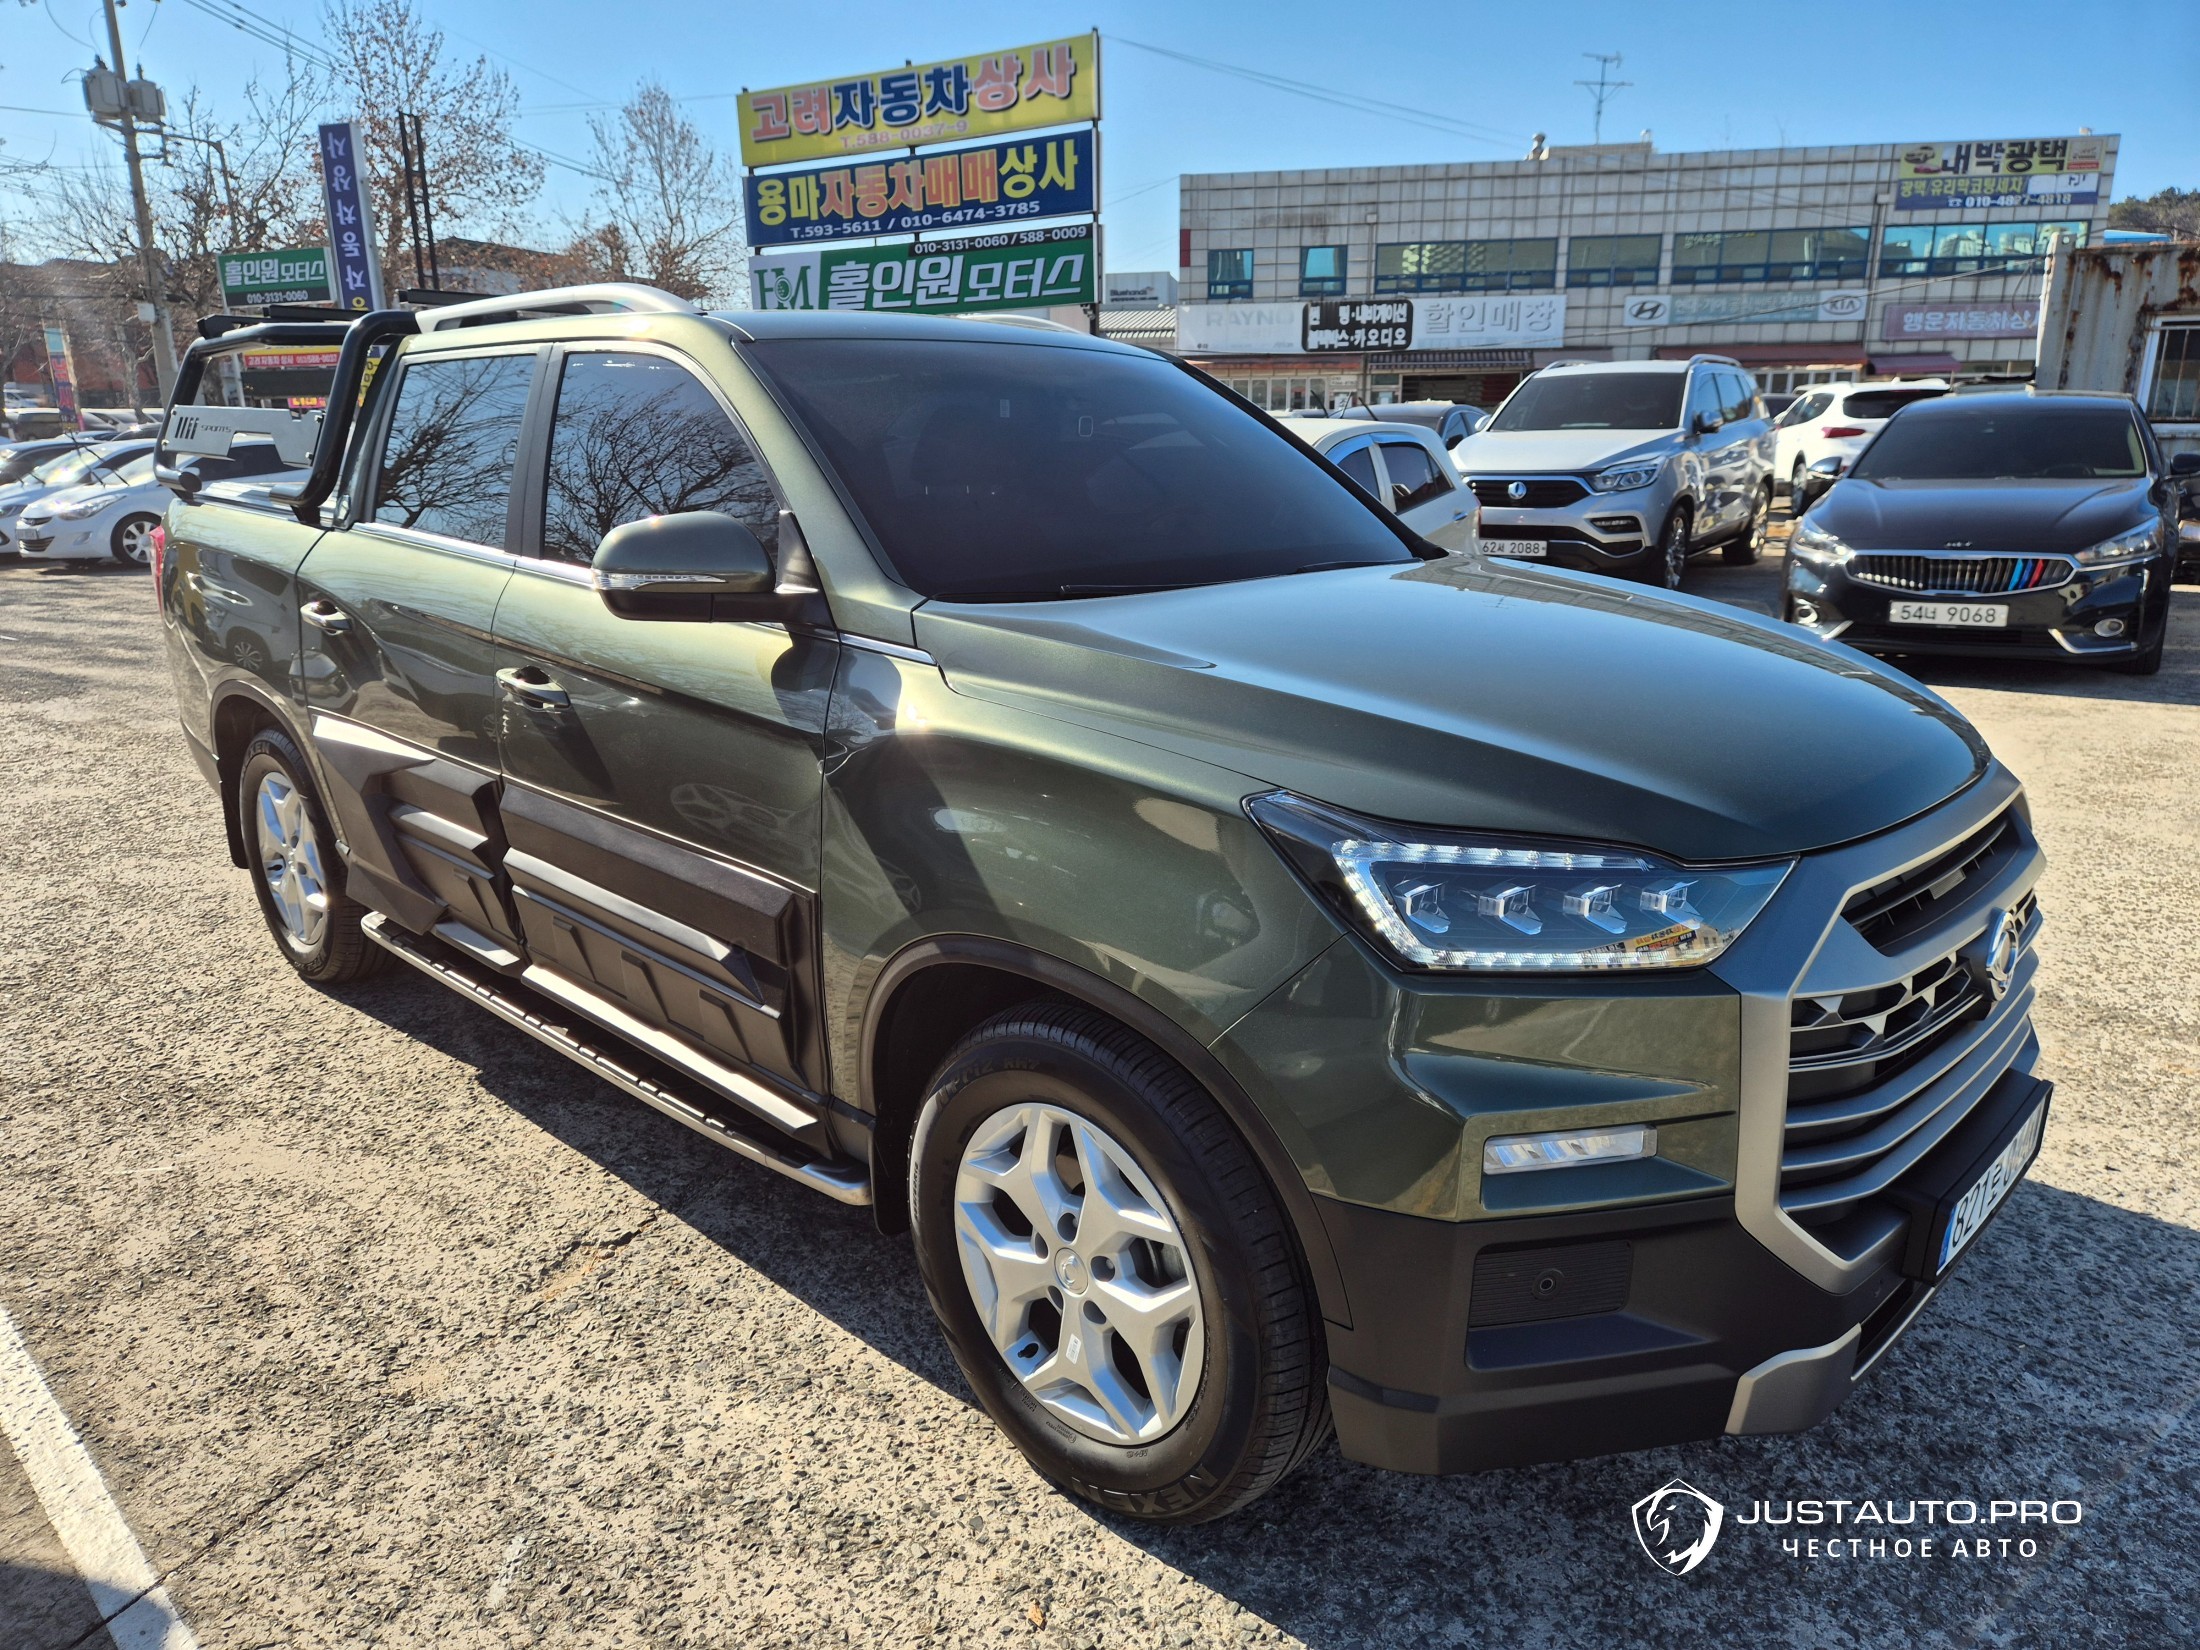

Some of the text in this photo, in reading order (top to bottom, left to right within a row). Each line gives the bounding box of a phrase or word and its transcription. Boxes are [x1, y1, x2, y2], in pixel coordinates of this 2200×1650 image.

[751, 43, 1076, 141] 고려자동차상사
[840, 119, 968, 149] T.588-0037-9
[757, 139, 1079, 226] 용마자동차매매상사
[790, 218, 882, 239] T.593-5611
[901, 200, 1041, 229] 010-6474-3785
[914, 234, 1009, 254] 010-3131-0060
[1019, 225, 1087, 244] 588-0009
[246, 290, 309, 304] 010-3131-0060
[1424, 299, 1556, 335] 할인매장
[1903, 310, 2040, 332] 행운자동차상
[1510, 542, 1540, 554] 2088
[1947, 606, 1996, 623] 9068
